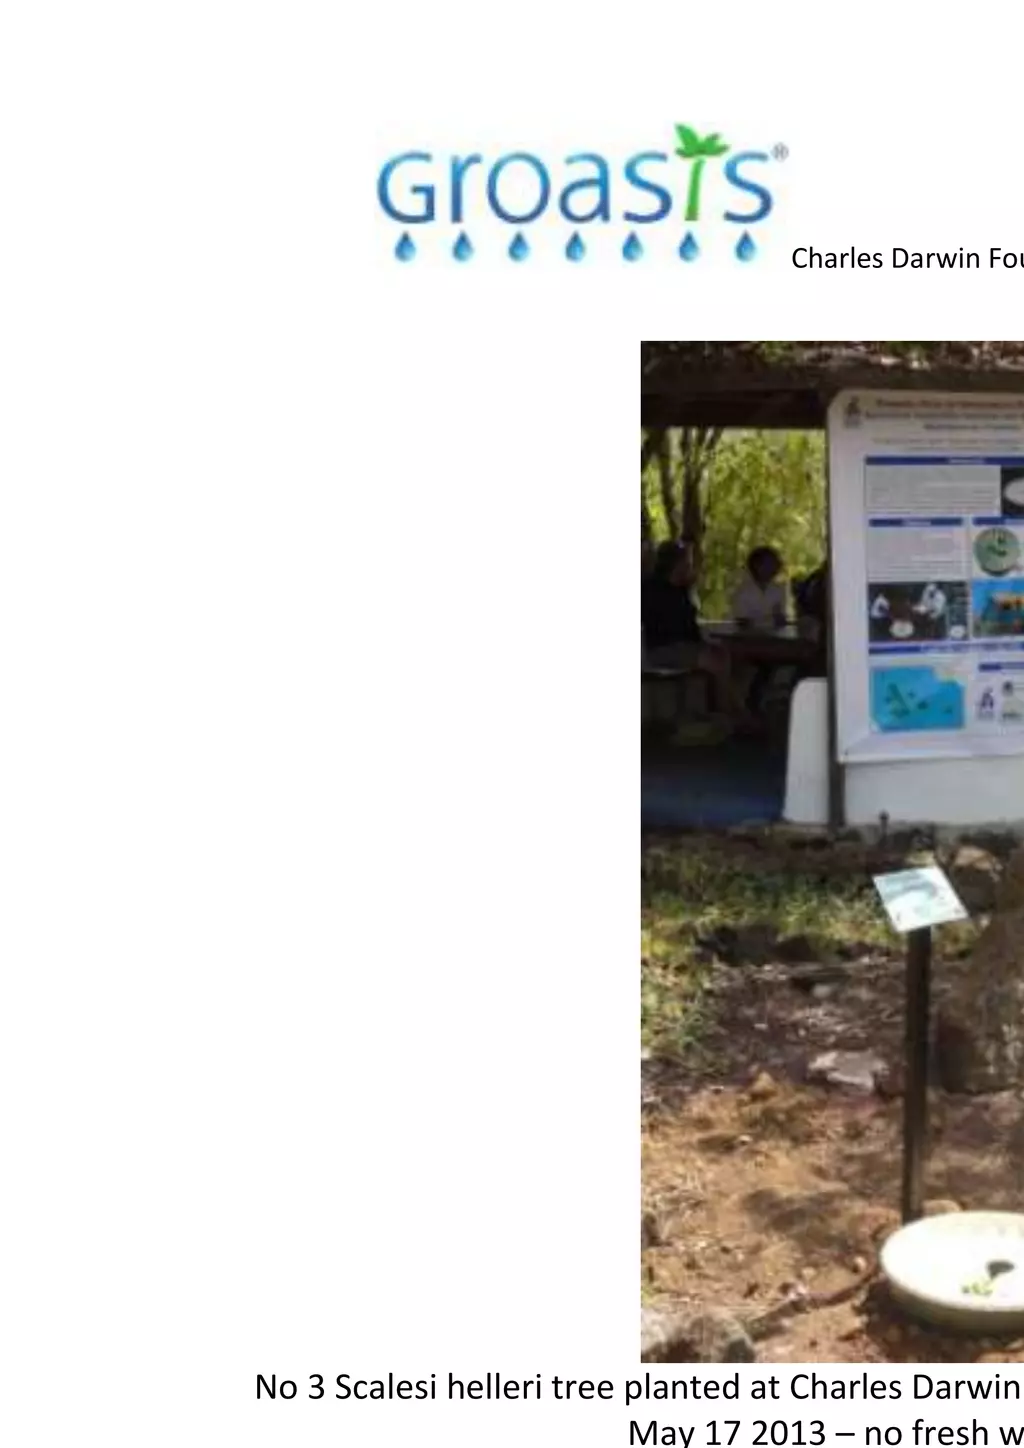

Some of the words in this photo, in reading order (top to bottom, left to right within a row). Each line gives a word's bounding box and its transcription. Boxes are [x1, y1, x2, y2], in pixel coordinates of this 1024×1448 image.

[791, 245, 884, 269] Charles
[892, 246, 980, 269] Darwin
[256, 1373, 298, 1400] No
[308, 1373, 325, 1400] 3
[335, 1372, 436, 1400] Scalesi
[448, 1372, 542, 1400] helleri
[551, 1375, 614, 1400] tree
[625, 1372, 740, 1407] planted
[750, 1375, 781, 1400] at
[790, 1372, 902, 1400] Charles
[913, 1373, 1020, 1400] Darwin
[706, 1420, 741, 1446] 17
[751, 1419, 826, 1446] 2013
[865, 1426, 903, 1446] no
[911, 1418, 989, 1446] fresh
